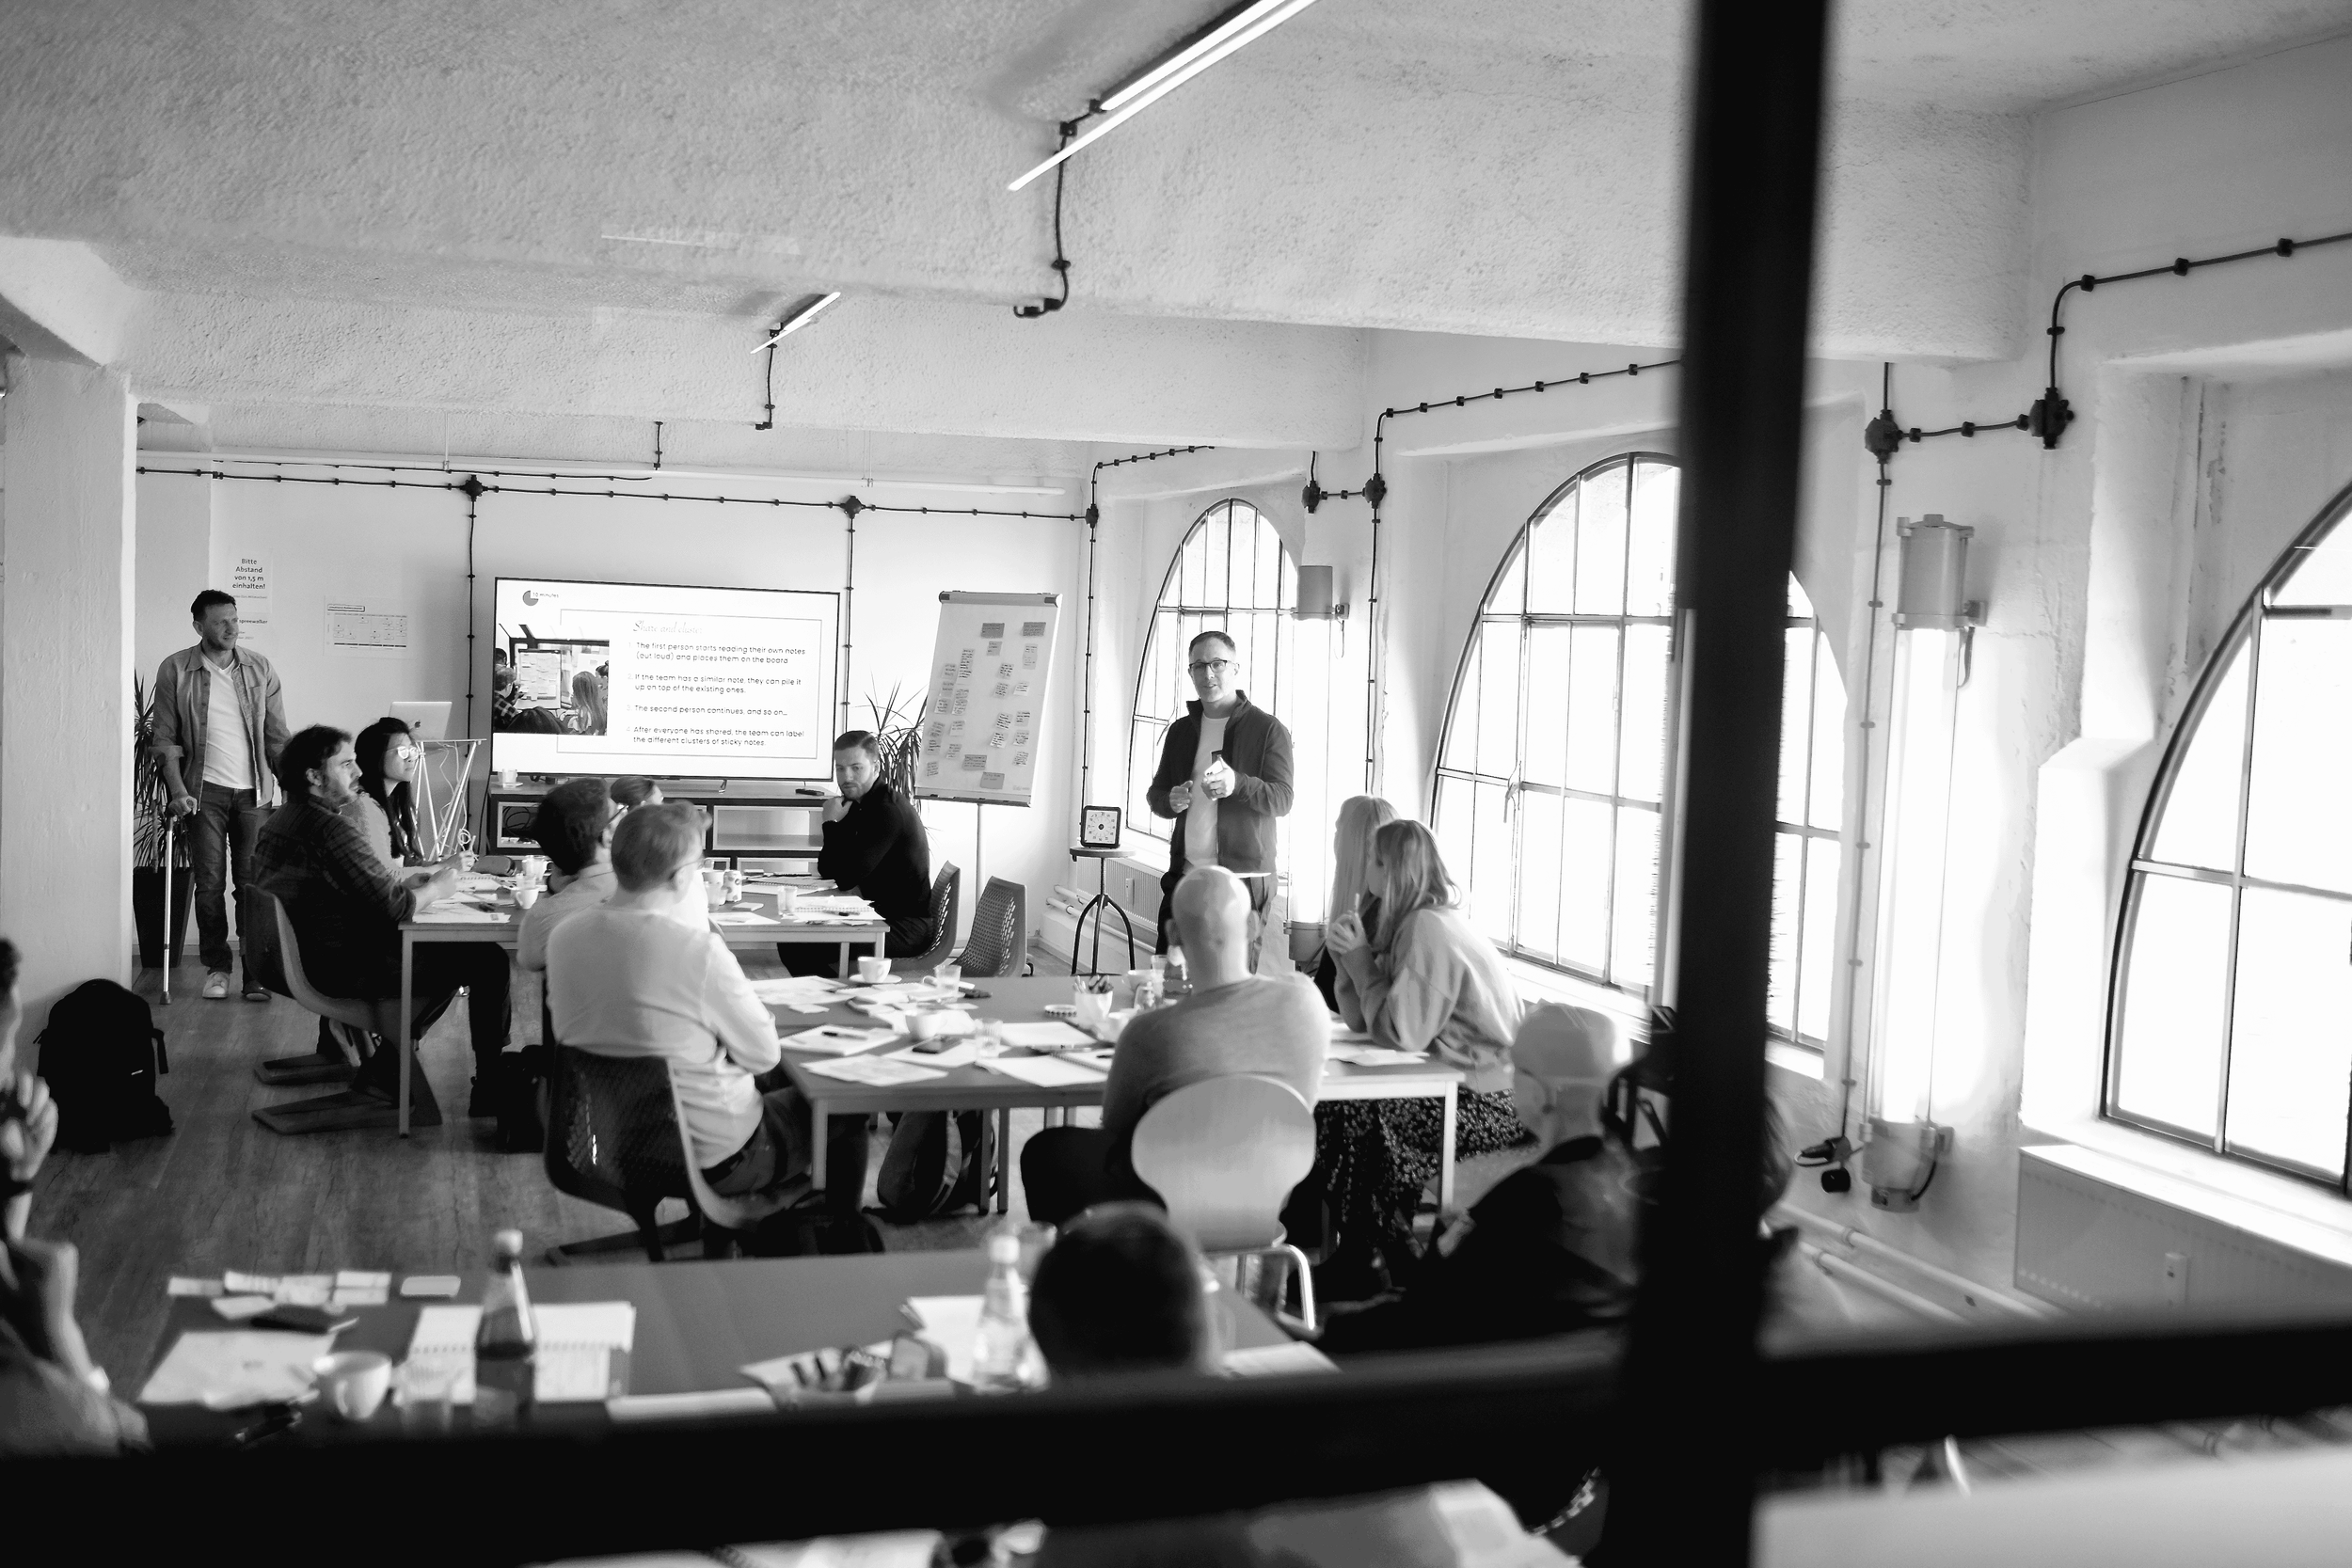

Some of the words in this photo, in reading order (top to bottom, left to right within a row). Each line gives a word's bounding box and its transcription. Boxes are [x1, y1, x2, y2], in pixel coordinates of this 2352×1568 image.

[660, 622, 677, 633] and
[636, 651, 652, 659] (out
[654, 652, 674, 660] loud)
[695, 685, 724, 694] existing
